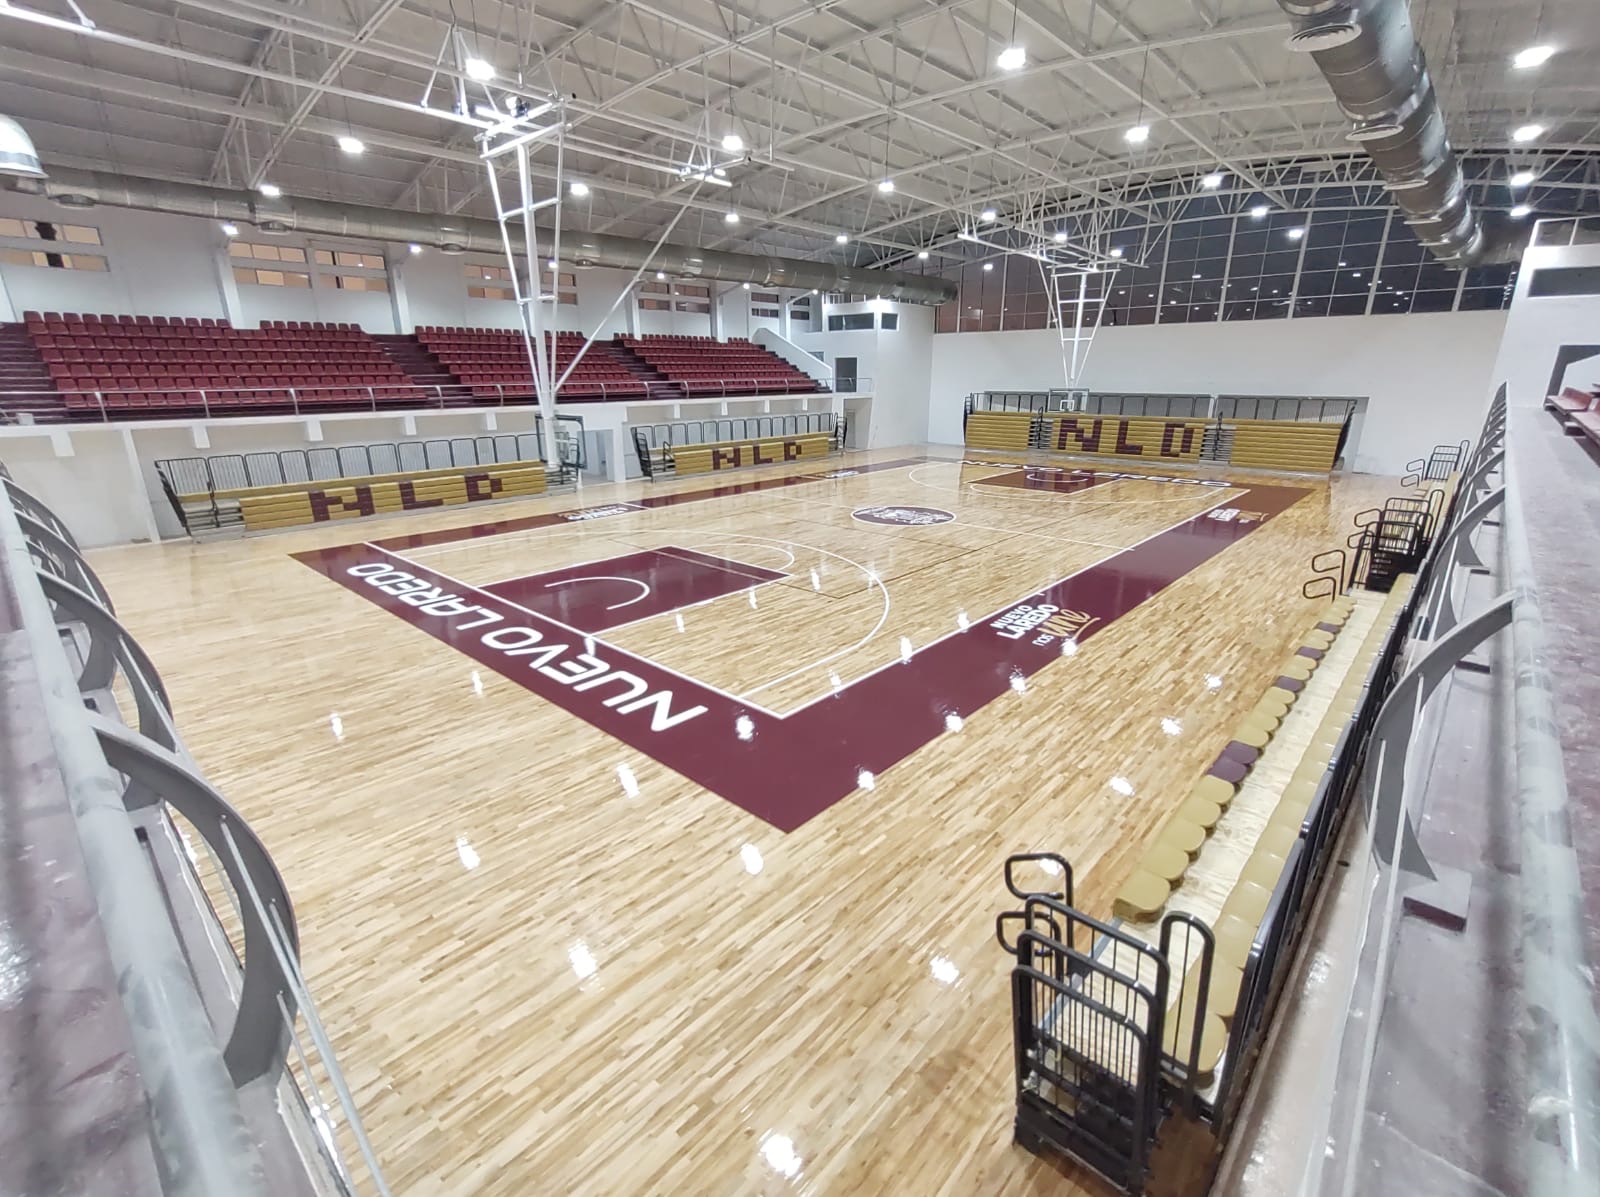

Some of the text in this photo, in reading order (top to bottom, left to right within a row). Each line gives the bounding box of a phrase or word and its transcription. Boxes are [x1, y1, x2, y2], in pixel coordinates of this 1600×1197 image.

[989, 604, 1033, 629] NUEVO
[996, 604, 1060, 639] LAREDO
[346, 563, 709, 732] NUEVO LAREDO
